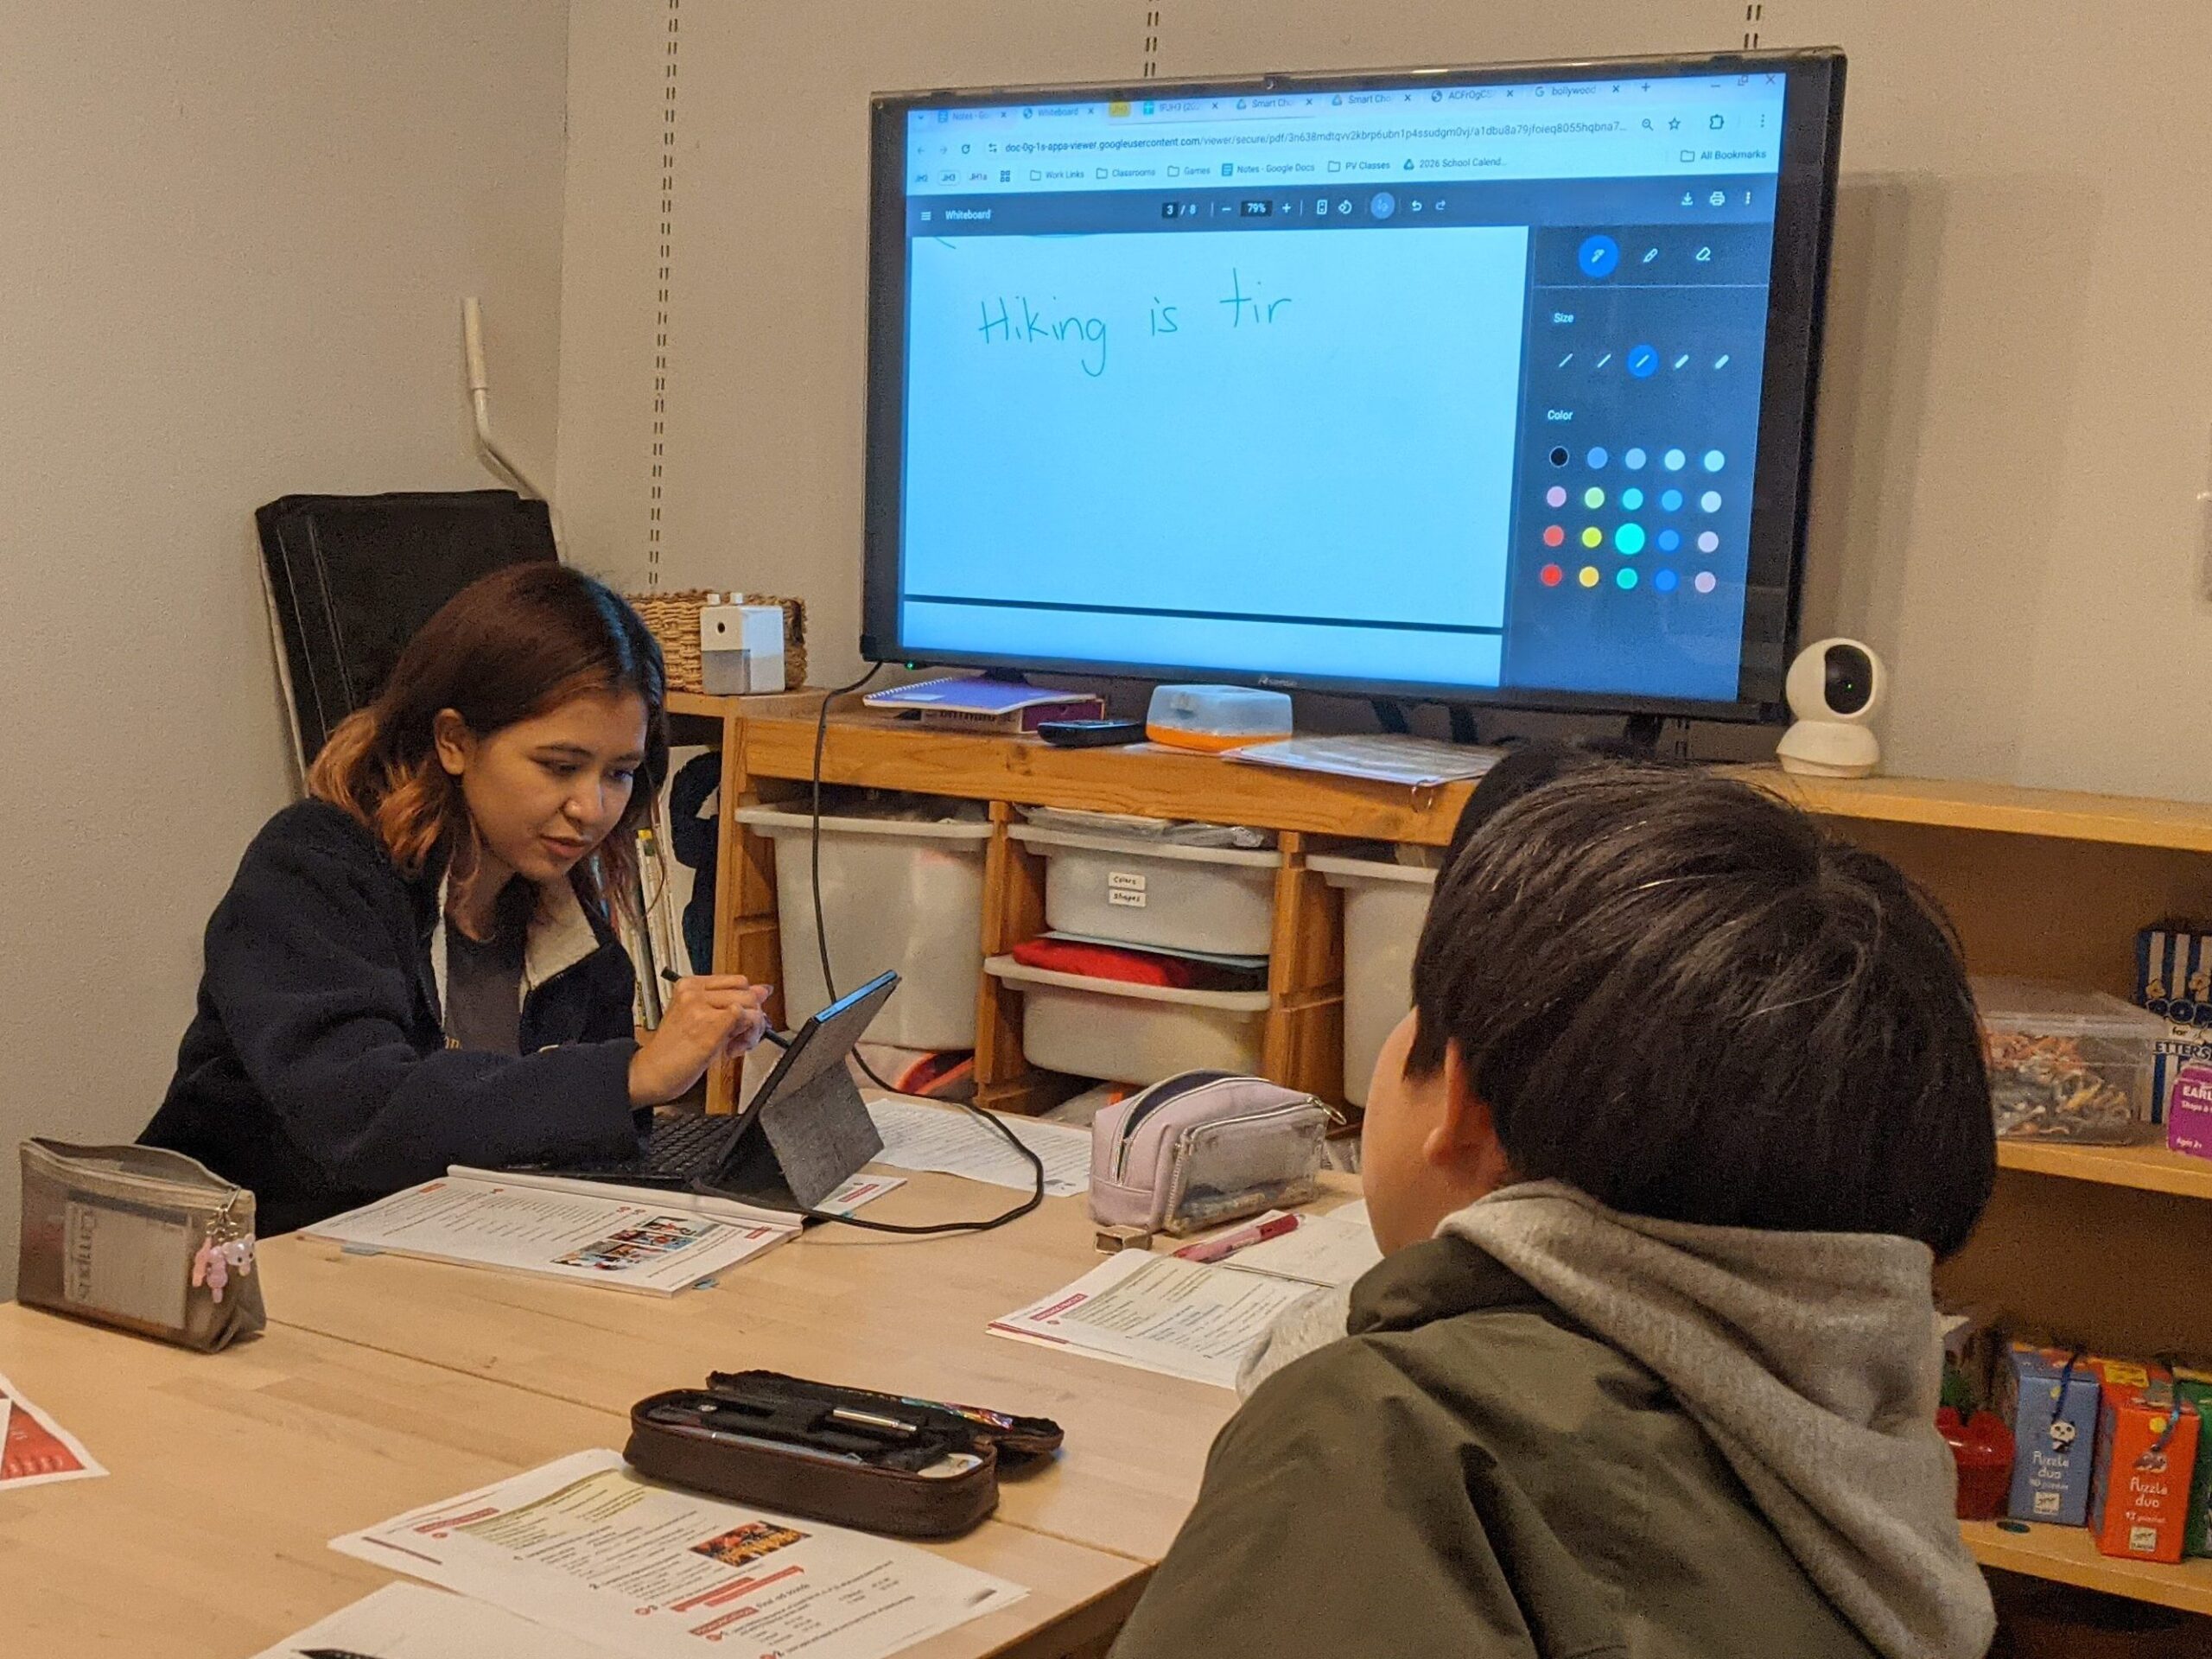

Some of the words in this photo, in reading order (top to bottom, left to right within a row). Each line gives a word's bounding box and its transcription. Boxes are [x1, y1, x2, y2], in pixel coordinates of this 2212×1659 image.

[1552, 86, 1597, 97] bollywood
[1252, 99, 1275, 108] Smart
[1348, 95, 1372, 105] Smart
[1700, 149, 1713, 160] All
[1714, 149, 1767, 160] Bookmarks
[1345, 161, 1357, 170] PV
[1358, 160, 1390, 170] Classes
[1442, 156, 1470, 167] School
[1046, 170, 1064, 179] Work
[1065, 169, 1084, 178] Links
[1112, 168, 1155, 178] Classrooms
[1184, 166, 1211, 175] Games
[1266, 163, 1293, 175] Google
[1295, 162, 1315, 172] Docs
[1166, 204, 1173, 215] 3
[1247, 202, 1267, 213] 79%
[945, 208, 991, 220] Whiteboard
[978, 296, 1107, 377] Hiking
[1150, 296, 1178, 336] is
[1219, 267, 1292, 328] tir
[1553, 312, 1574, 323] Size
[1547, 409, 1573, 421] Color
[2172, 1026, 2189, 1036] for
[2135, 1494, 2160, 1508] duo
